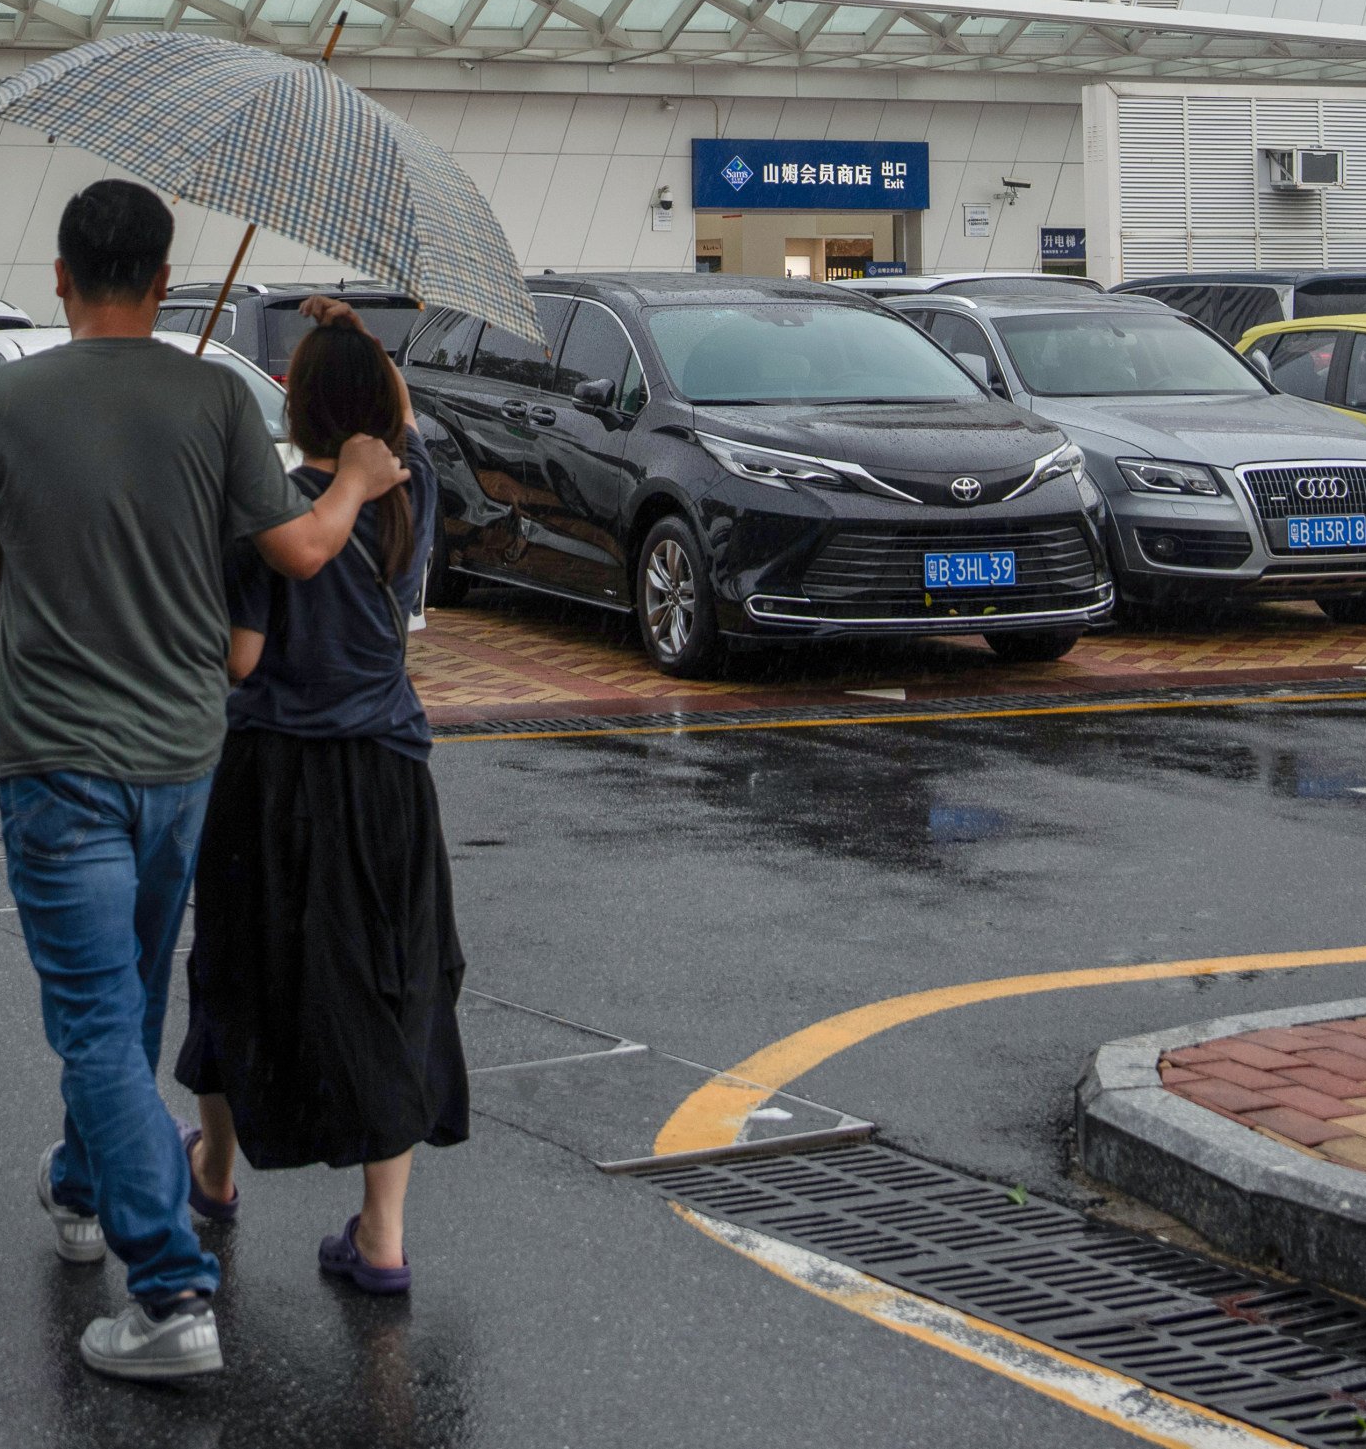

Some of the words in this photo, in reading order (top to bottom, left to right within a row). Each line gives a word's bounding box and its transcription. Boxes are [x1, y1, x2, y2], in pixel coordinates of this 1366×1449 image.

[763, 163, 872, 186] 山姆会员商店
[881, 161, 907, 176] 出口
[884, 178, 904, 189] Exit
